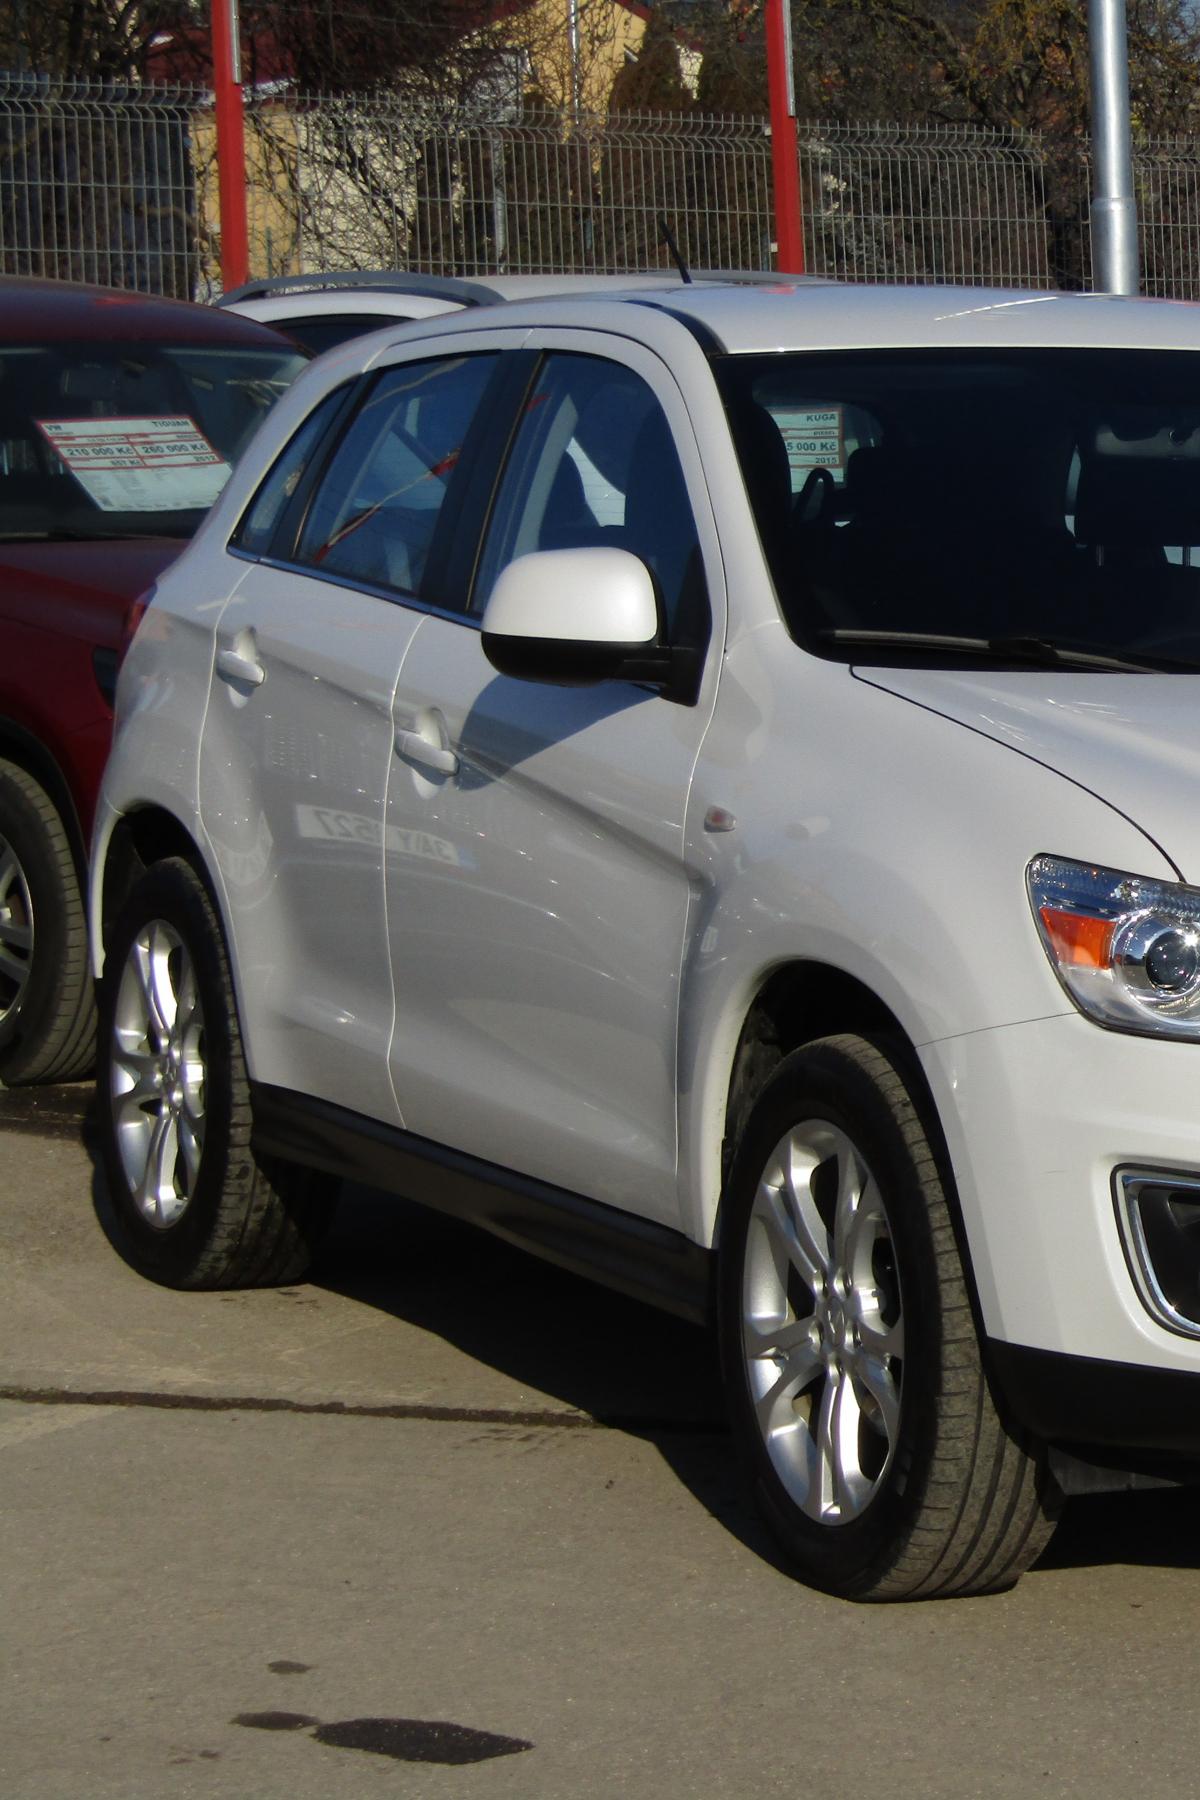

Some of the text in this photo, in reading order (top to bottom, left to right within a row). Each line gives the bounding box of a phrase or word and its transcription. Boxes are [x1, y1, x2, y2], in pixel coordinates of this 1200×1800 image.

[806, 413, 836, 422] KUGA
[92, 447, 114, 456] 000
[115, 446, 135, 455] Kč
[166, 444, 189, 453] 000
[190, 442, 209, 451] Kč
[796, 442, 817, 451] 000
[820, 441, 837, 451] Kč
